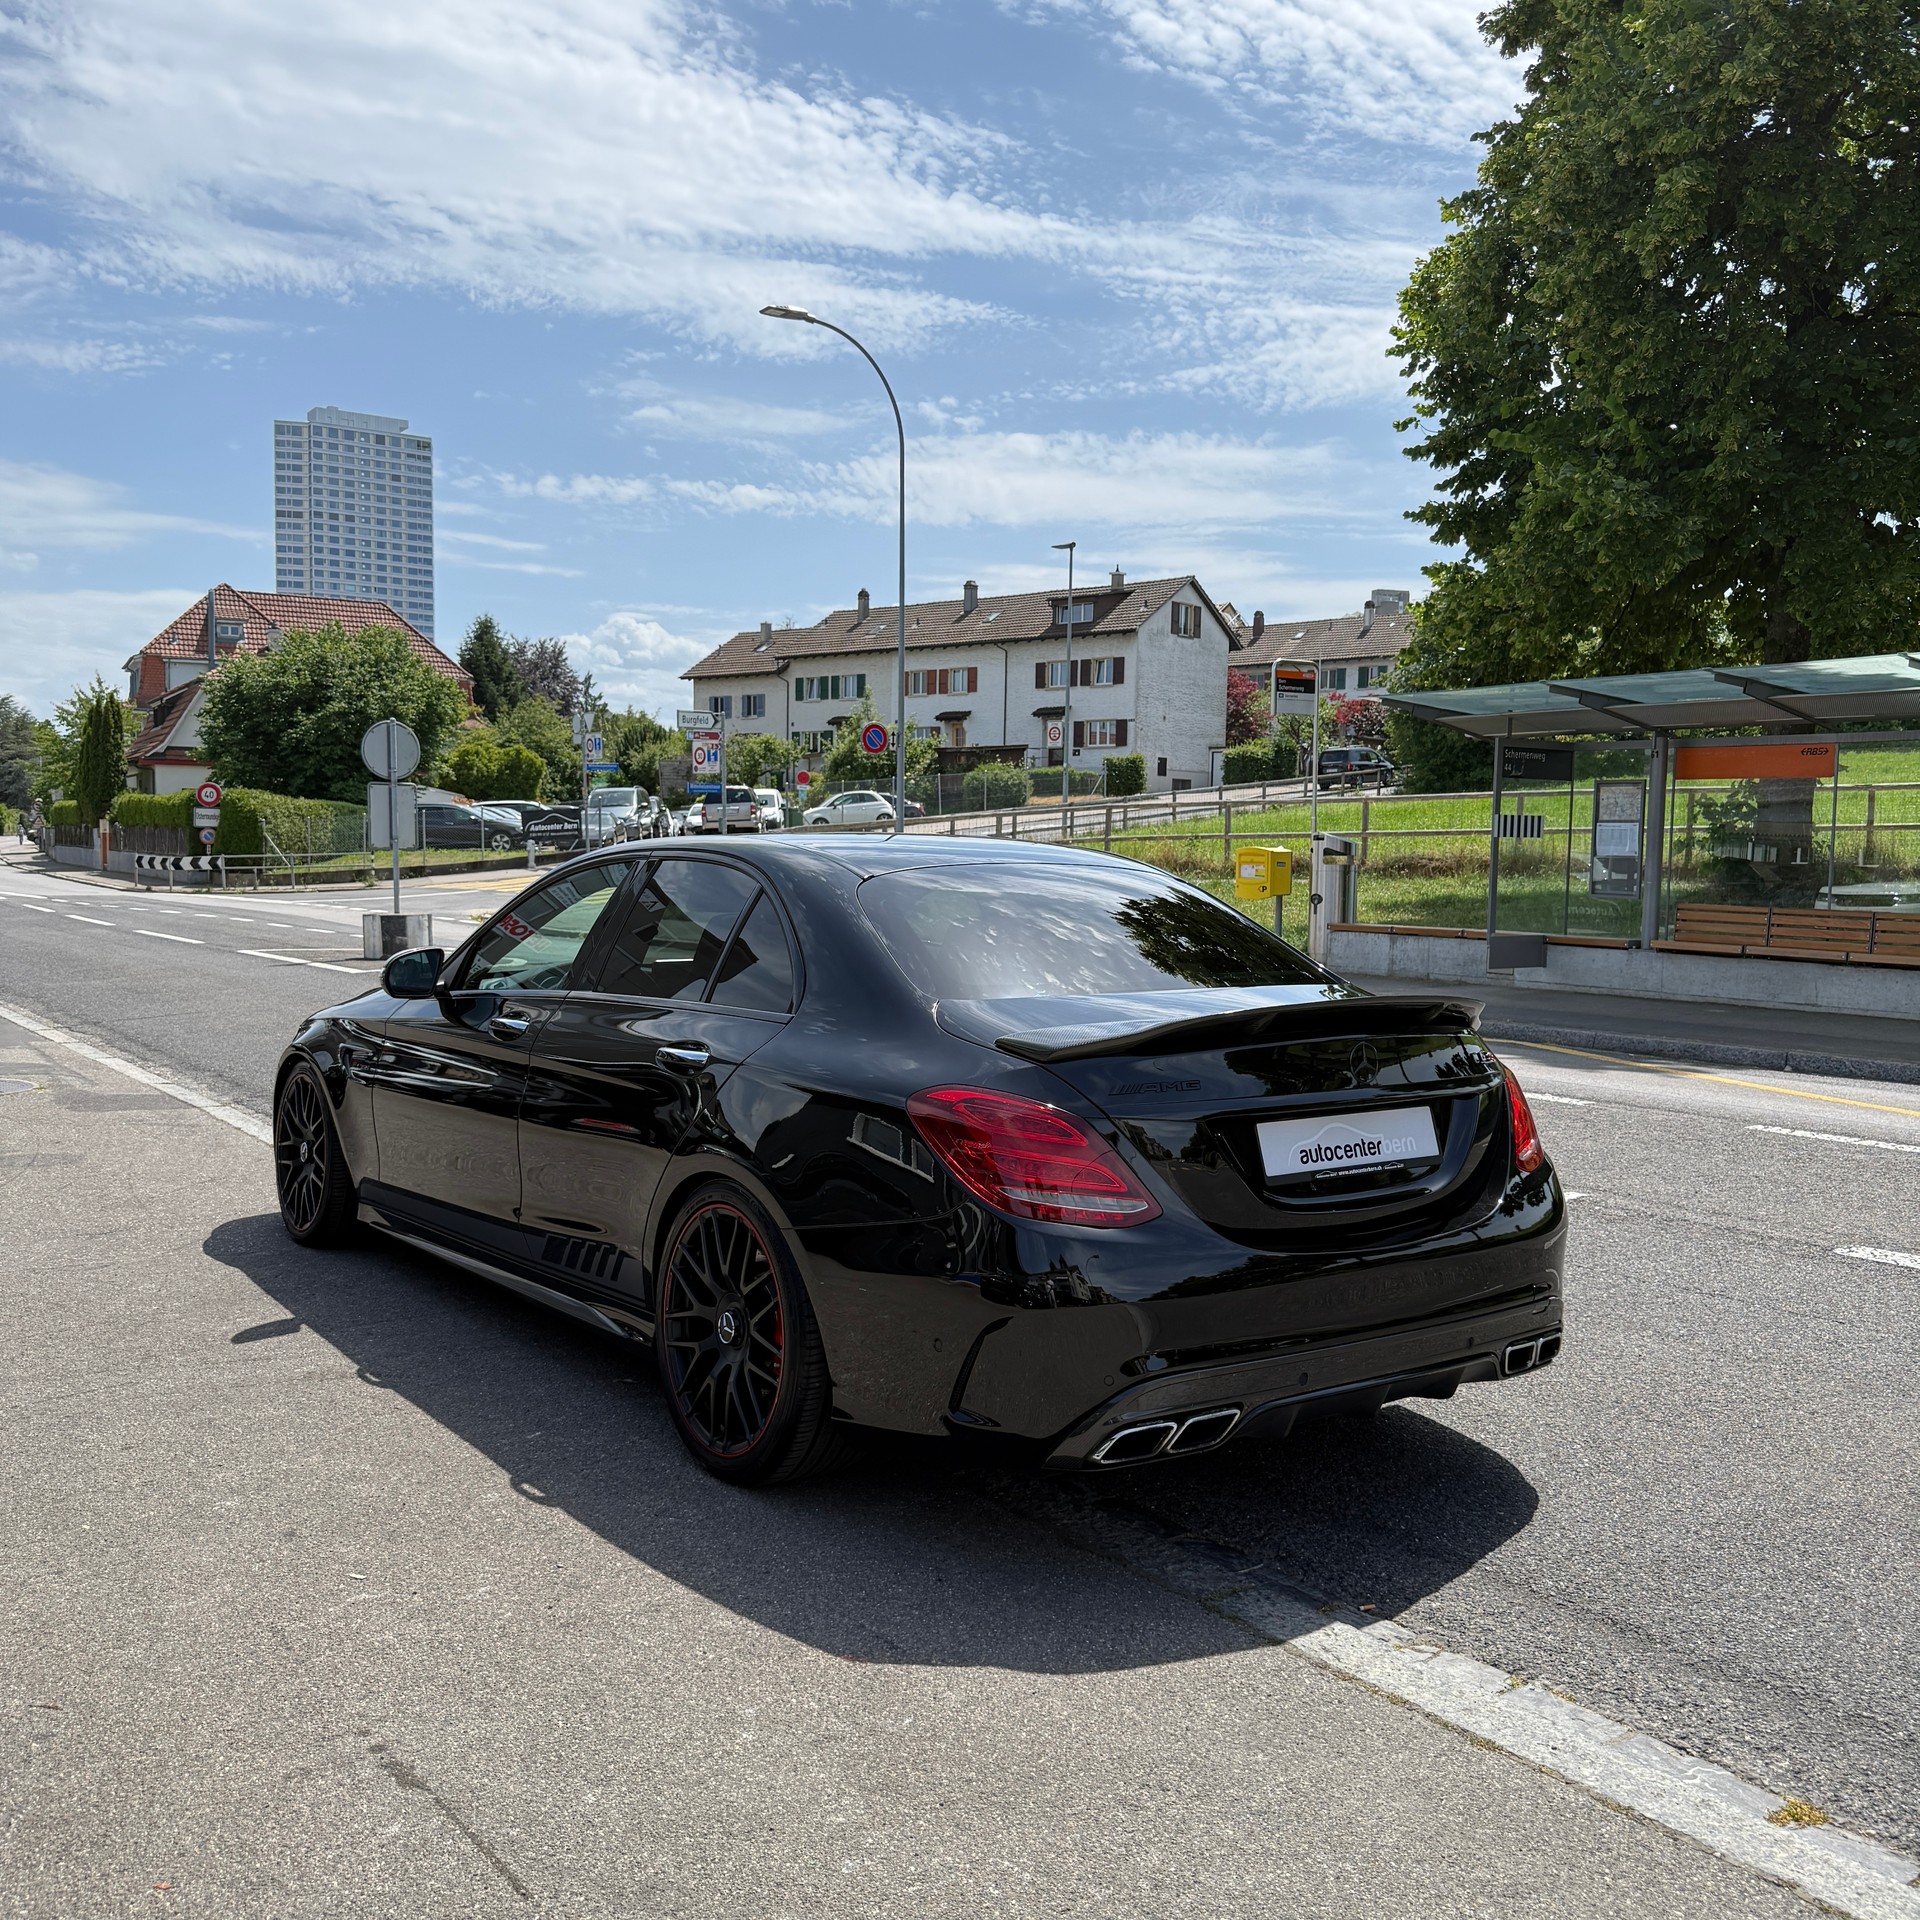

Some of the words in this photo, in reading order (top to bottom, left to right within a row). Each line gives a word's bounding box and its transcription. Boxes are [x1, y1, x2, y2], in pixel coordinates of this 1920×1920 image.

[682, 715, 709, 726] Burgfeld
[1504, 749, 1546, 762] Schermenweg
[1804, 747, 1825, 756] RBS
[1504, 763, 1513, 771] 44
[204, 791, 215, 799] 40
[530, 823, 564, 832] Autocenter
[1140, 1080, 1202, 1094] AMG
